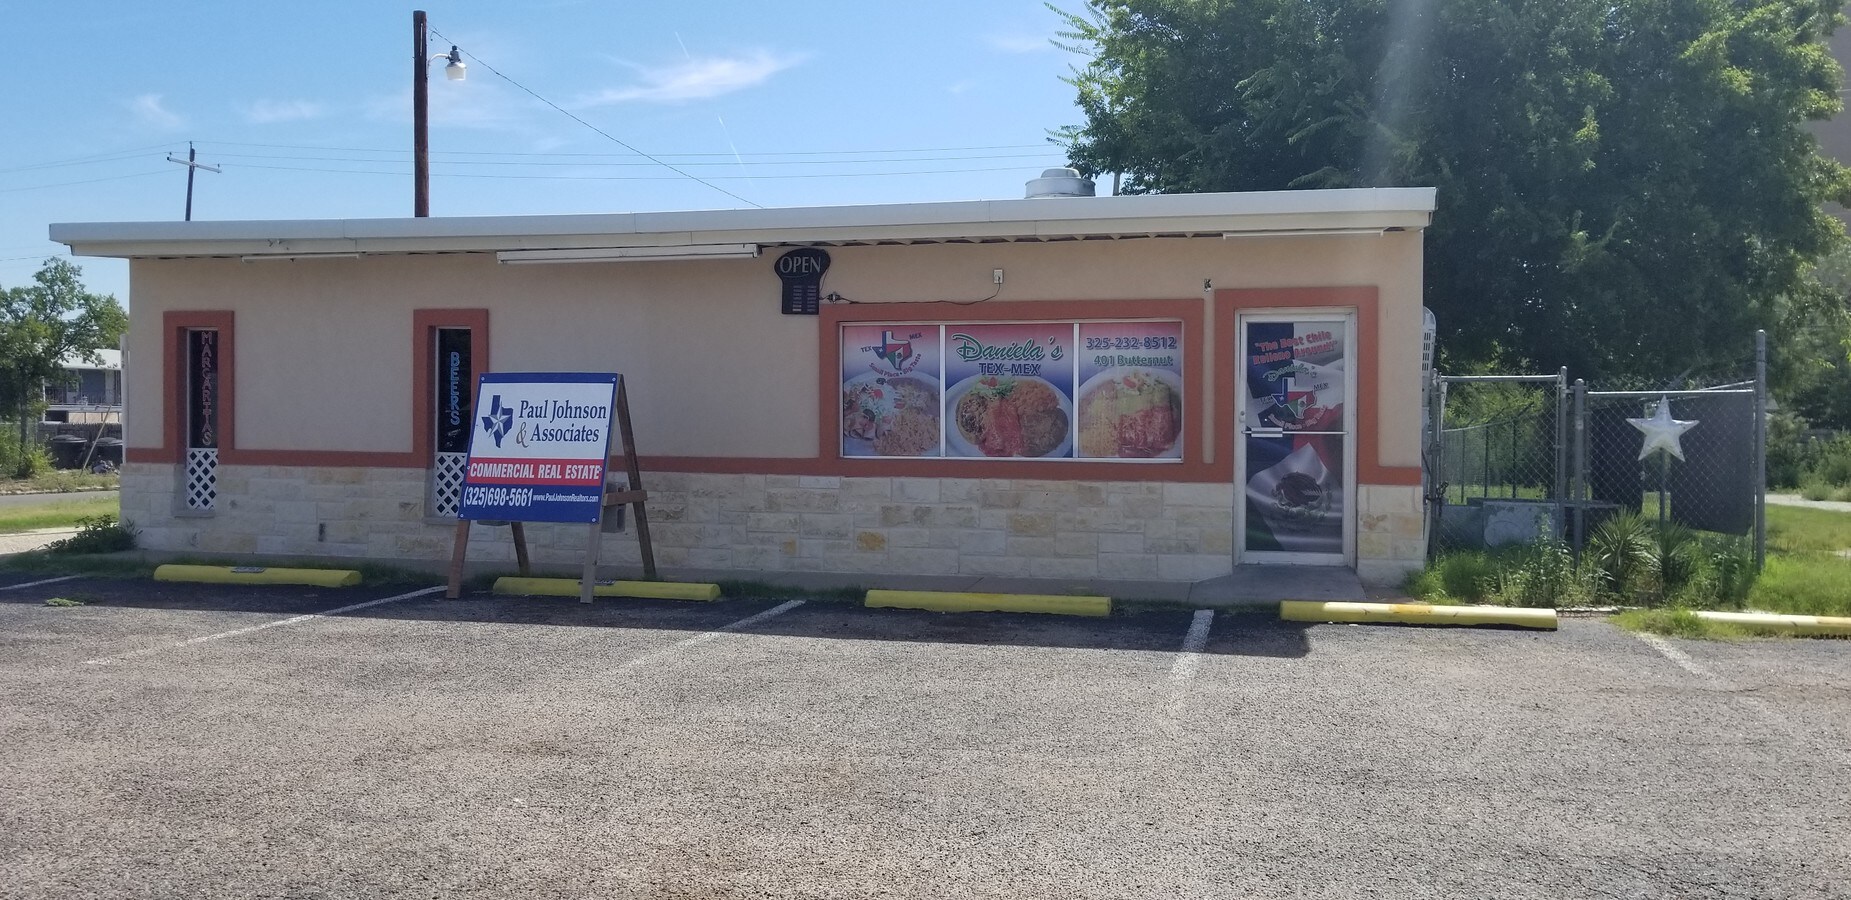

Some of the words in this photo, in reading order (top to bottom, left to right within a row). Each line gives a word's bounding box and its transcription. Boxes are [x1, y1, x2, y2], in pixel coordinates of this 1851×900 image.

[780, 256, 821, 273] OPEN
[909, 332, 923, 340] MEX
[1086, 336, 1177, 350] 325-232-8512
[1280, 336, 1304, 349] Best
[1306, 331, 1332, 343] Chile
[860, 345, 872, 353] TEX
[952, 333, 1064, 362] Daniela's
[978, 363, 1041, 375] TEX-MEX
[1094, 355, 1115, 366] 401
[1117, 355, 1174, 366] Butternut
[450, 351, 460, 426] BEERS
[518, 400, 548, 419] Paul
[550, 400, 607, 423] Johnson
[516, 421, 529, 448] &
[530, 423, 600, 443] Associates
[470, 463, 535, 478] COMMERCIAL
[538, 464, 562, 479] REAL
[565, 465, 600, 480] ESTATE
[463, 486, 533, 508] (325)698-5661
[532, 493, 599, 503] www.PaulJohnsonRealtors.com
